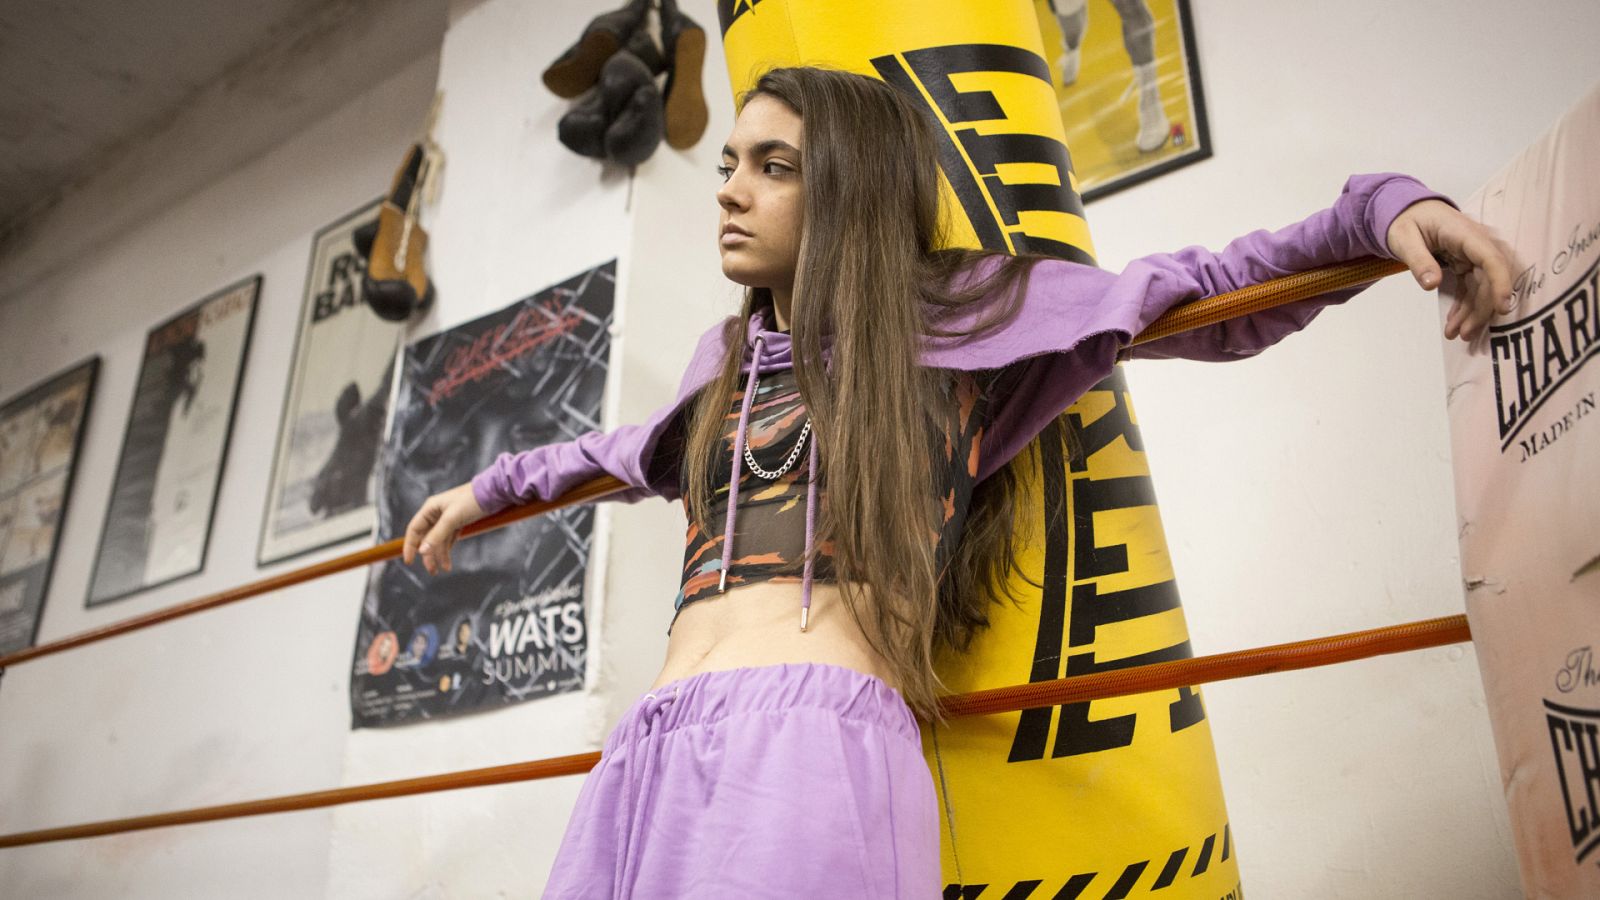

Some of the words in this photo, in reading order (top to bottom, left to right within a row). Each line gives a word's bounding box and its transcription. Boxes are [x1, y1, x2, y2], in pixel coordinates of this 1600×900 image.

[1509, 264, 1546, 312] The
[1519, 411, 1575, 463] MADE
[1575, 392, 1597, 420] IN
[489, 602, 584, 659] WATS
[481, 645, 586, 686] SUMMIT
[1555, 645, 1600, 693] Th
